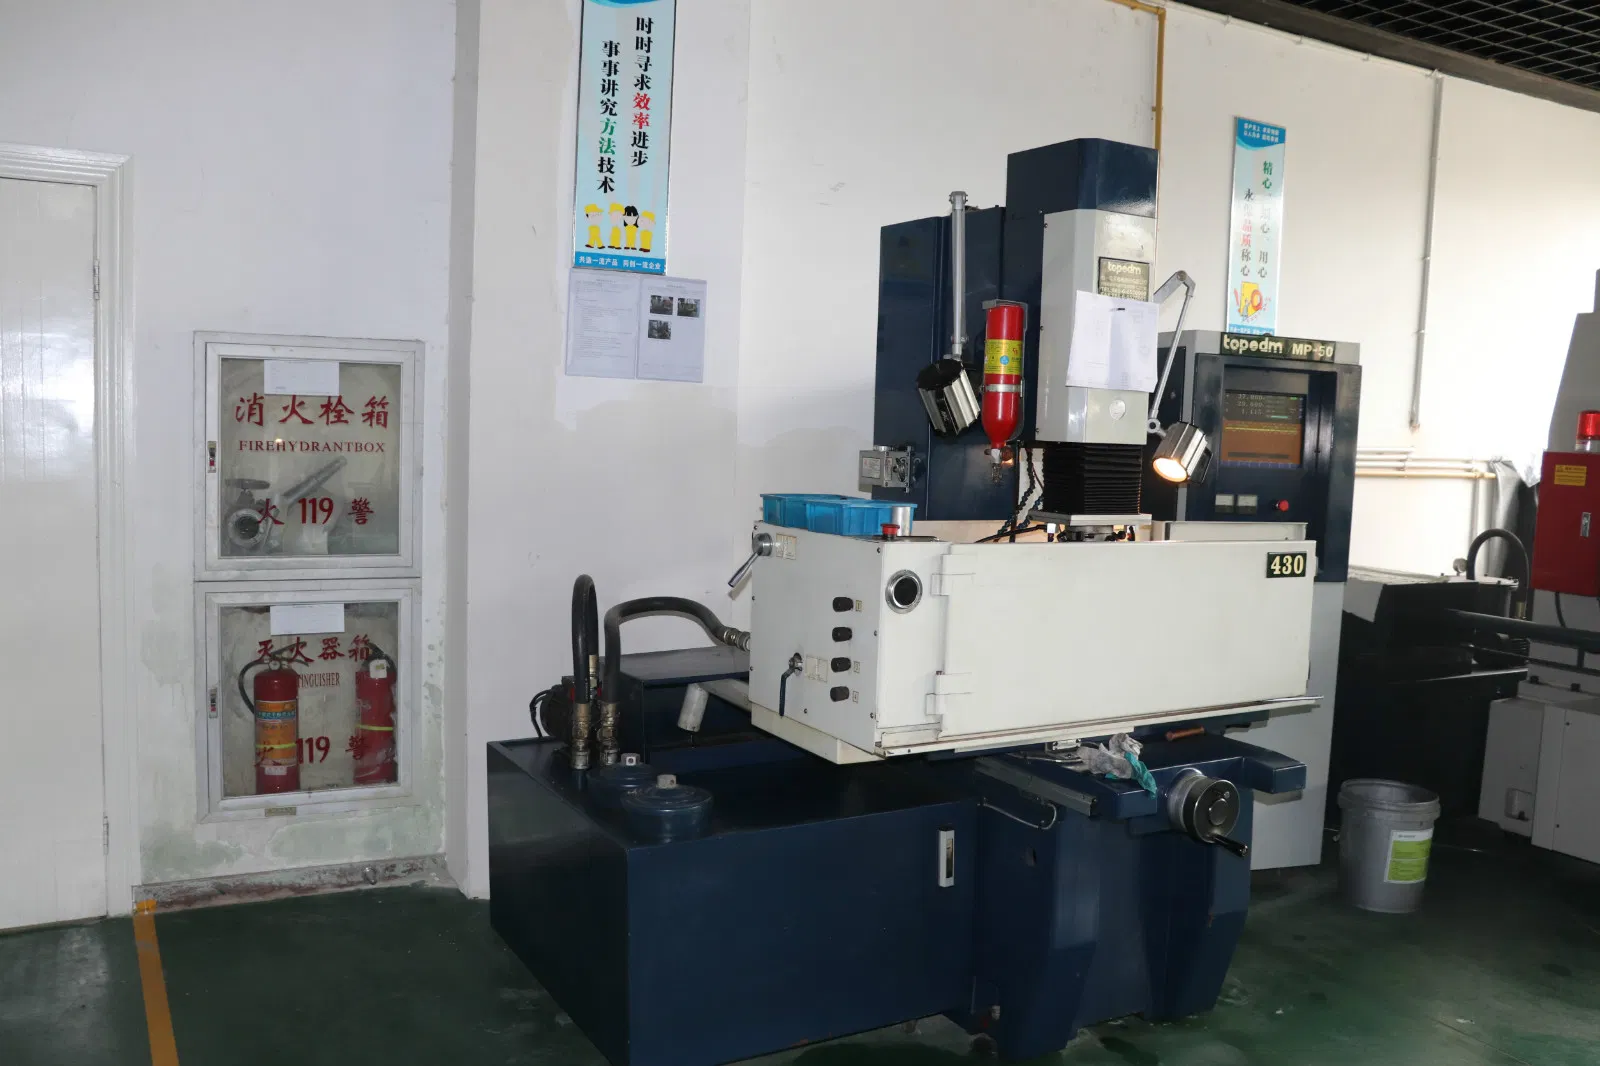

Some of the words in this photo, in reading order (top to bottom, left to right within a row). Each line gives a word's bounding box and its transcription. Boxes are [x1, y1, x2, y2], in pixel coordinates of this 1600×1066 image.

[630, 16, 654, 167] 时时寻求效率进步
[597, 40, 621, 194] 事事讲究方法技术
[1107, 261, 1142, 275] topedm
[1223, 334, 1283, 354] topedm
[1292, 343, 1334, 358] MP-50
[235, 392, 390, 428] 消火栓箱
[257, 498, 285, 525] 火
[298, 498, 334, 524] 119
[348, 498, 374, 525] 警
[1271, 555, 1304, 575] 430
[255, 634, 371, 664] 灭火器箱
[296, 736, 331, 764] 119
